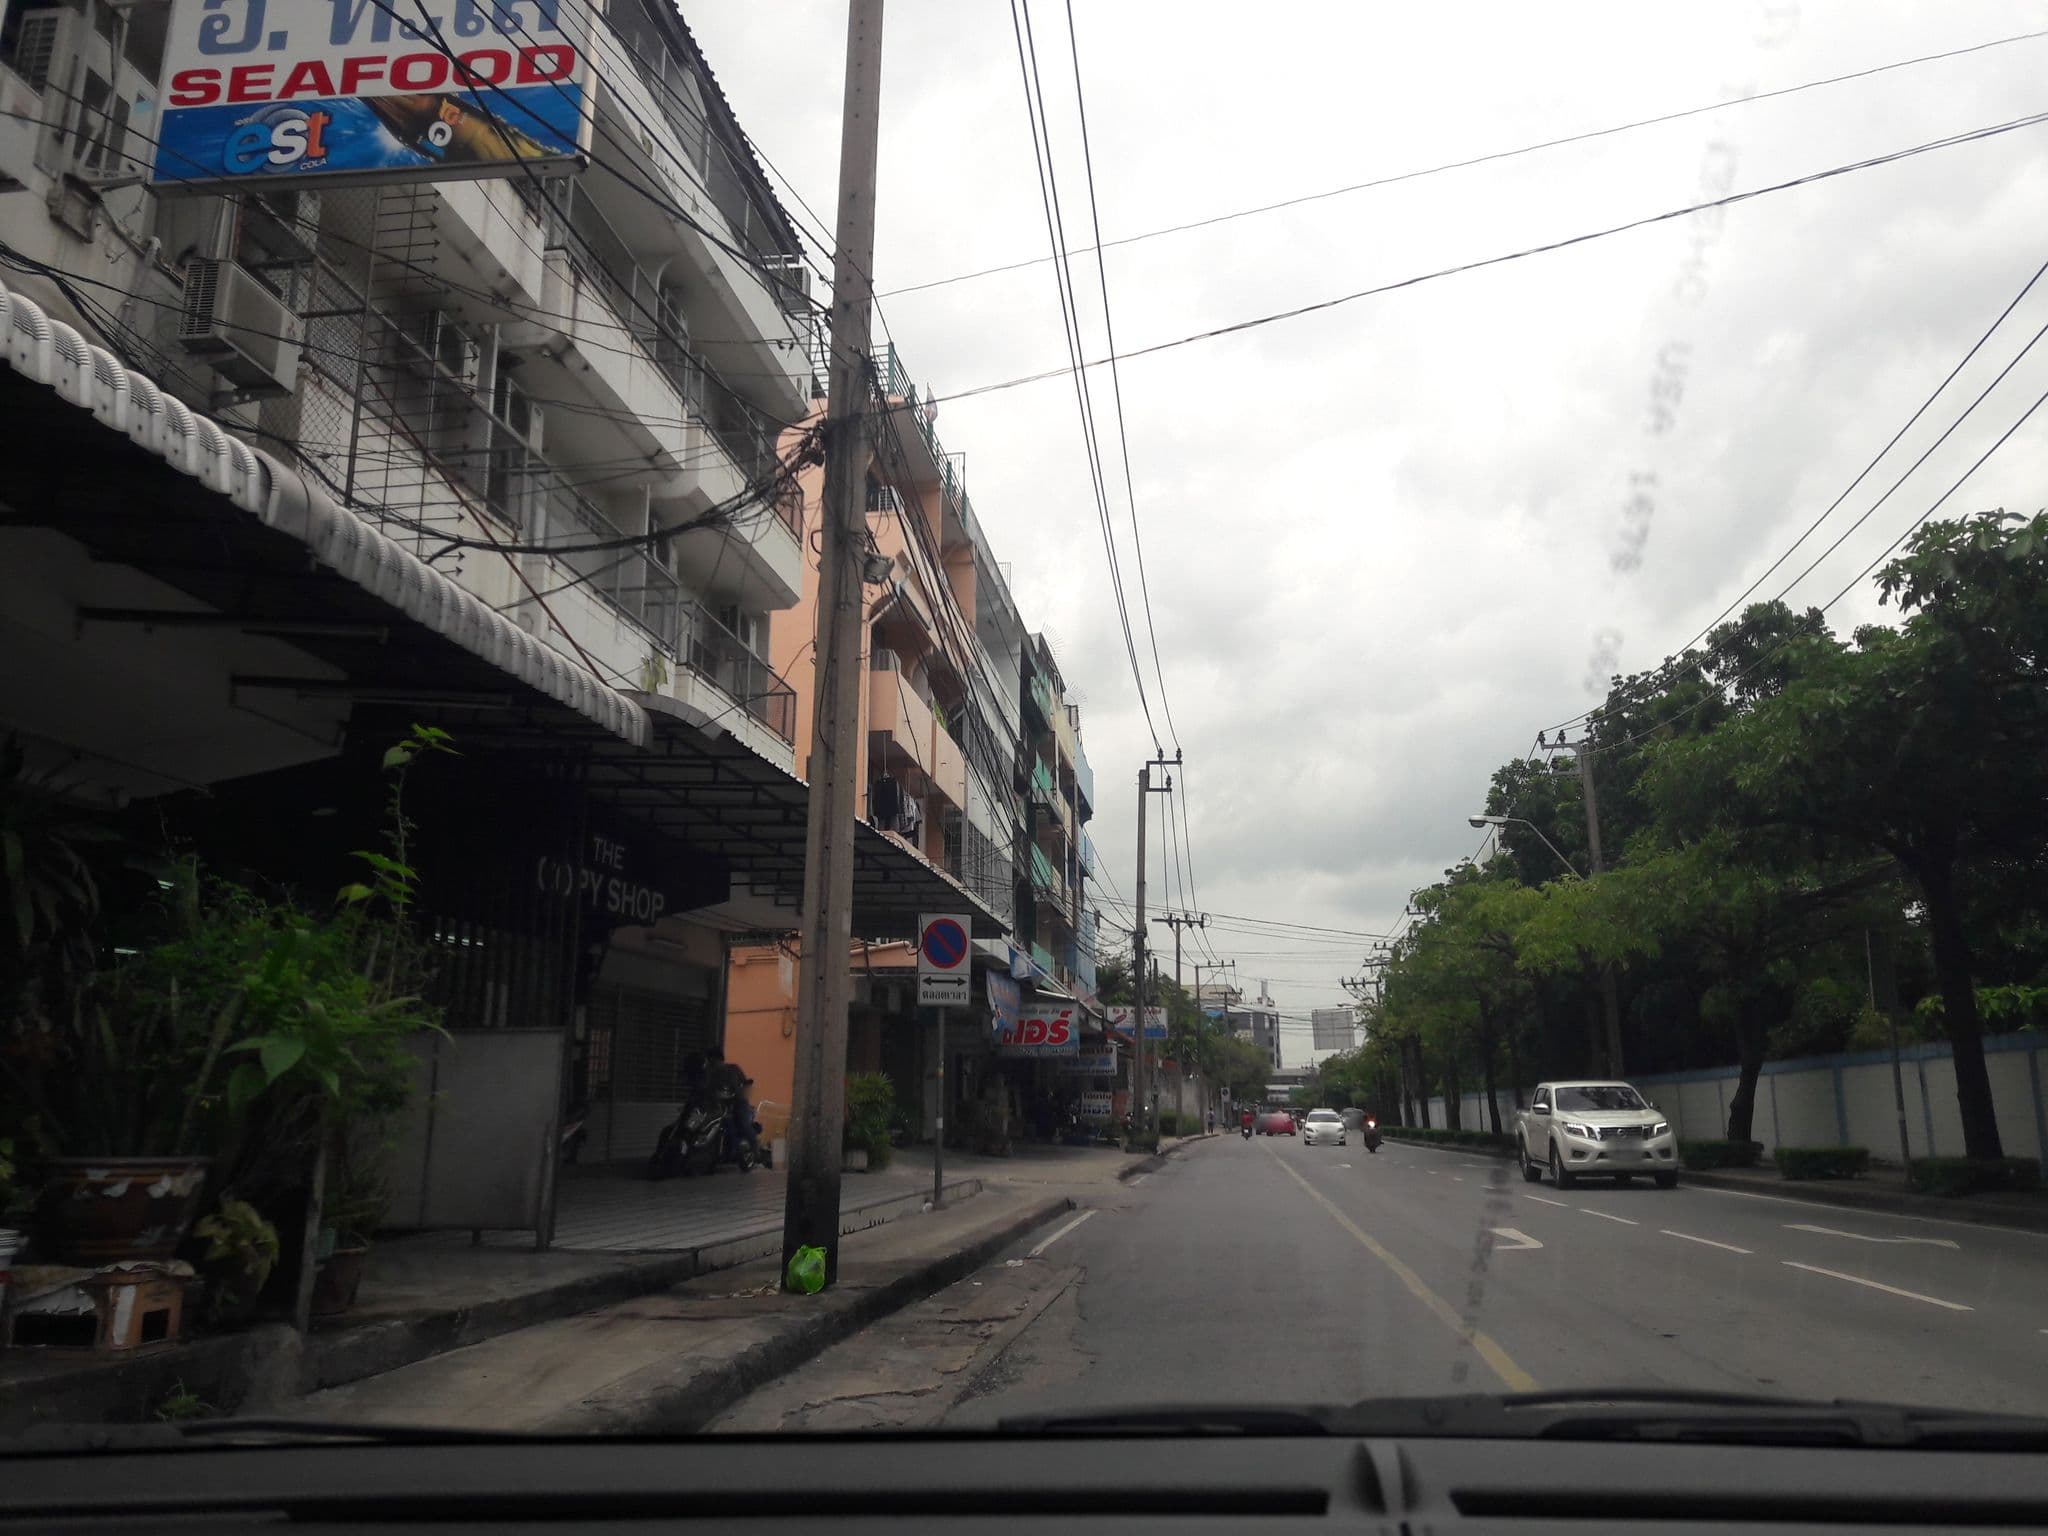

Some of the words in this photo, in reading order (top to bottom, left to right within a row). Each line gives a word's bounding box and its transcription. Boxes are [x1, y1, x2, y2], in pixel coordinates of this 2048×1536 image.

[168, 44, 576, 106] SEAFOOD
[223, 111, 330, 173] est
[300, 157, 328, 171] COLA
[593, 836, 626, 870] THE
[607, 877, 665, 924] SHOP
